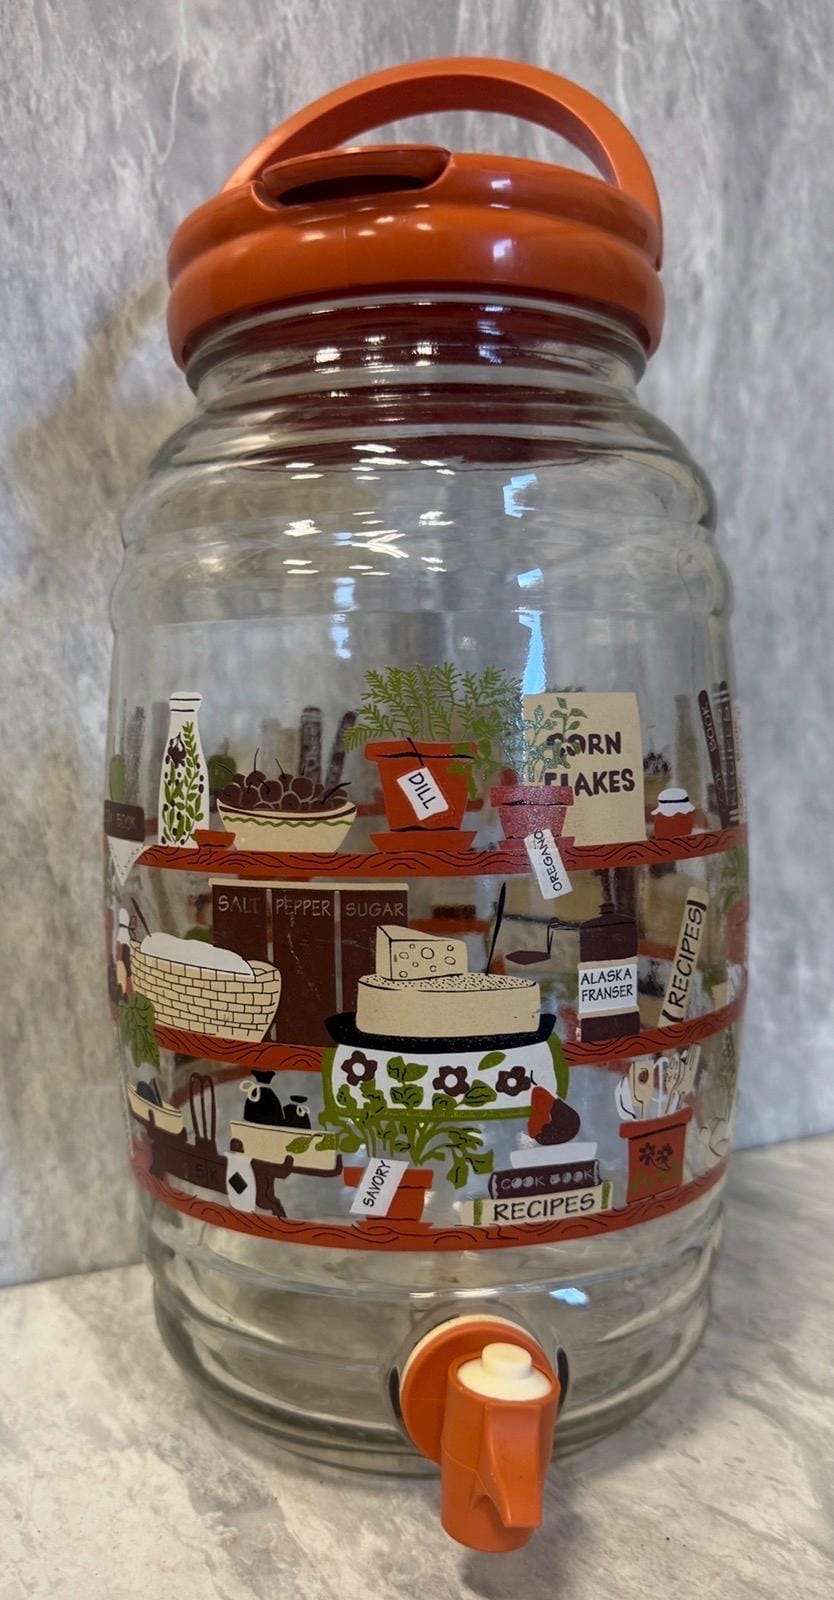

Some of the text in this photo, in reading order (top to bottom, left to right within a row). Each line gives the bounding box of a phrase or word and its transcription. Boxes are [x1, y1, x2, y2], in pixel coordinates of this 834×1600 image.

[408, 772, 436, 810] DILL
[533, 829, 563, 892] OREGANO
[217, 895, 260, 914] SALT
[276, 898, 332, 917] PEPPER
[345, 902, 405, 918] SUGAR
[668, 906, 703, 1009] RECIPES
[580, 967, 633, 986] ALASKA
[581, 983, 634, 1002] FRANSER
[362, 1159, 391, 1207] SAVORY
[500, 1168, 594, 1190] COOK BOOK
[493, 1193, 596, 1221] RECIPES
